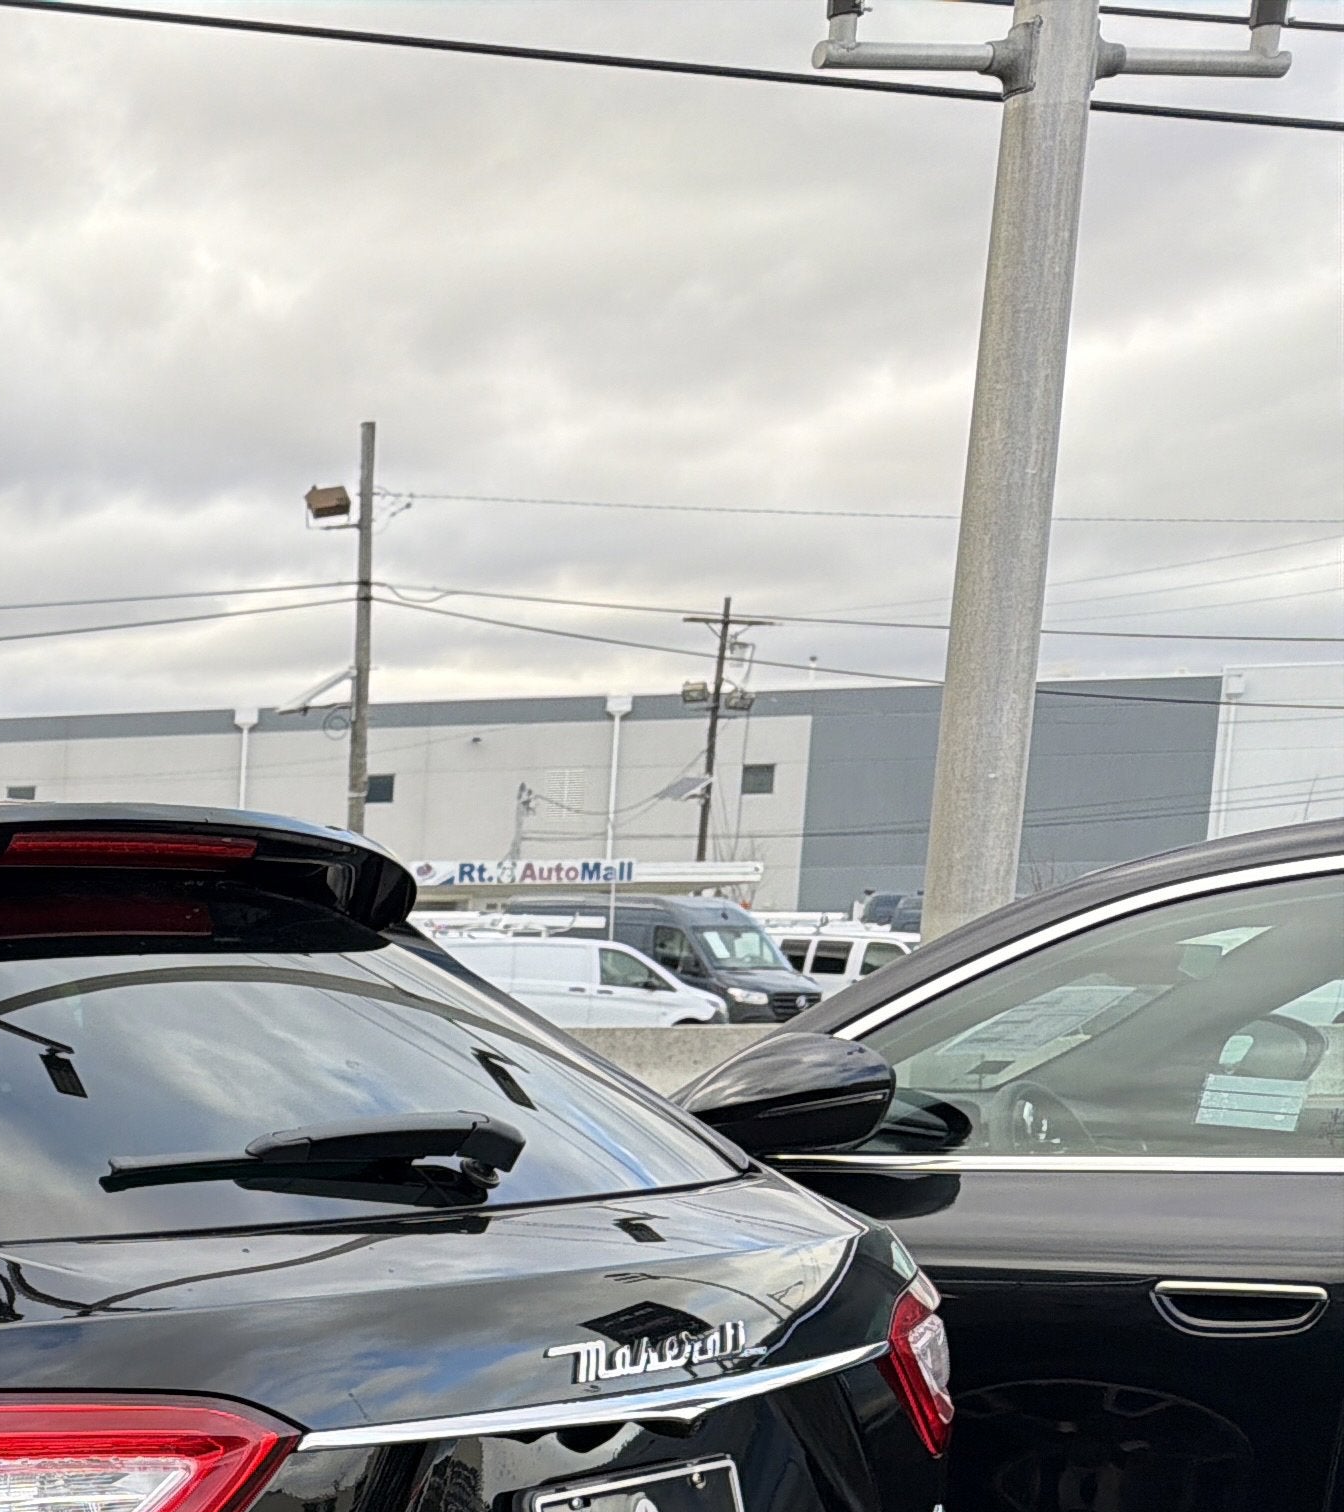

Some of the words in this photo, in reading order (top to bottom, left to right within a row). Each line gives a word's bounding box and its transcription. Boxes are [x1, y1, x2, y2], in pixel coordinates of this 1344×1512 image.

[458, 862, 494, 883] Rt.
[519, 861, 634, 882] AutoMall
[545, 1320, 766, 1384] Maserati
